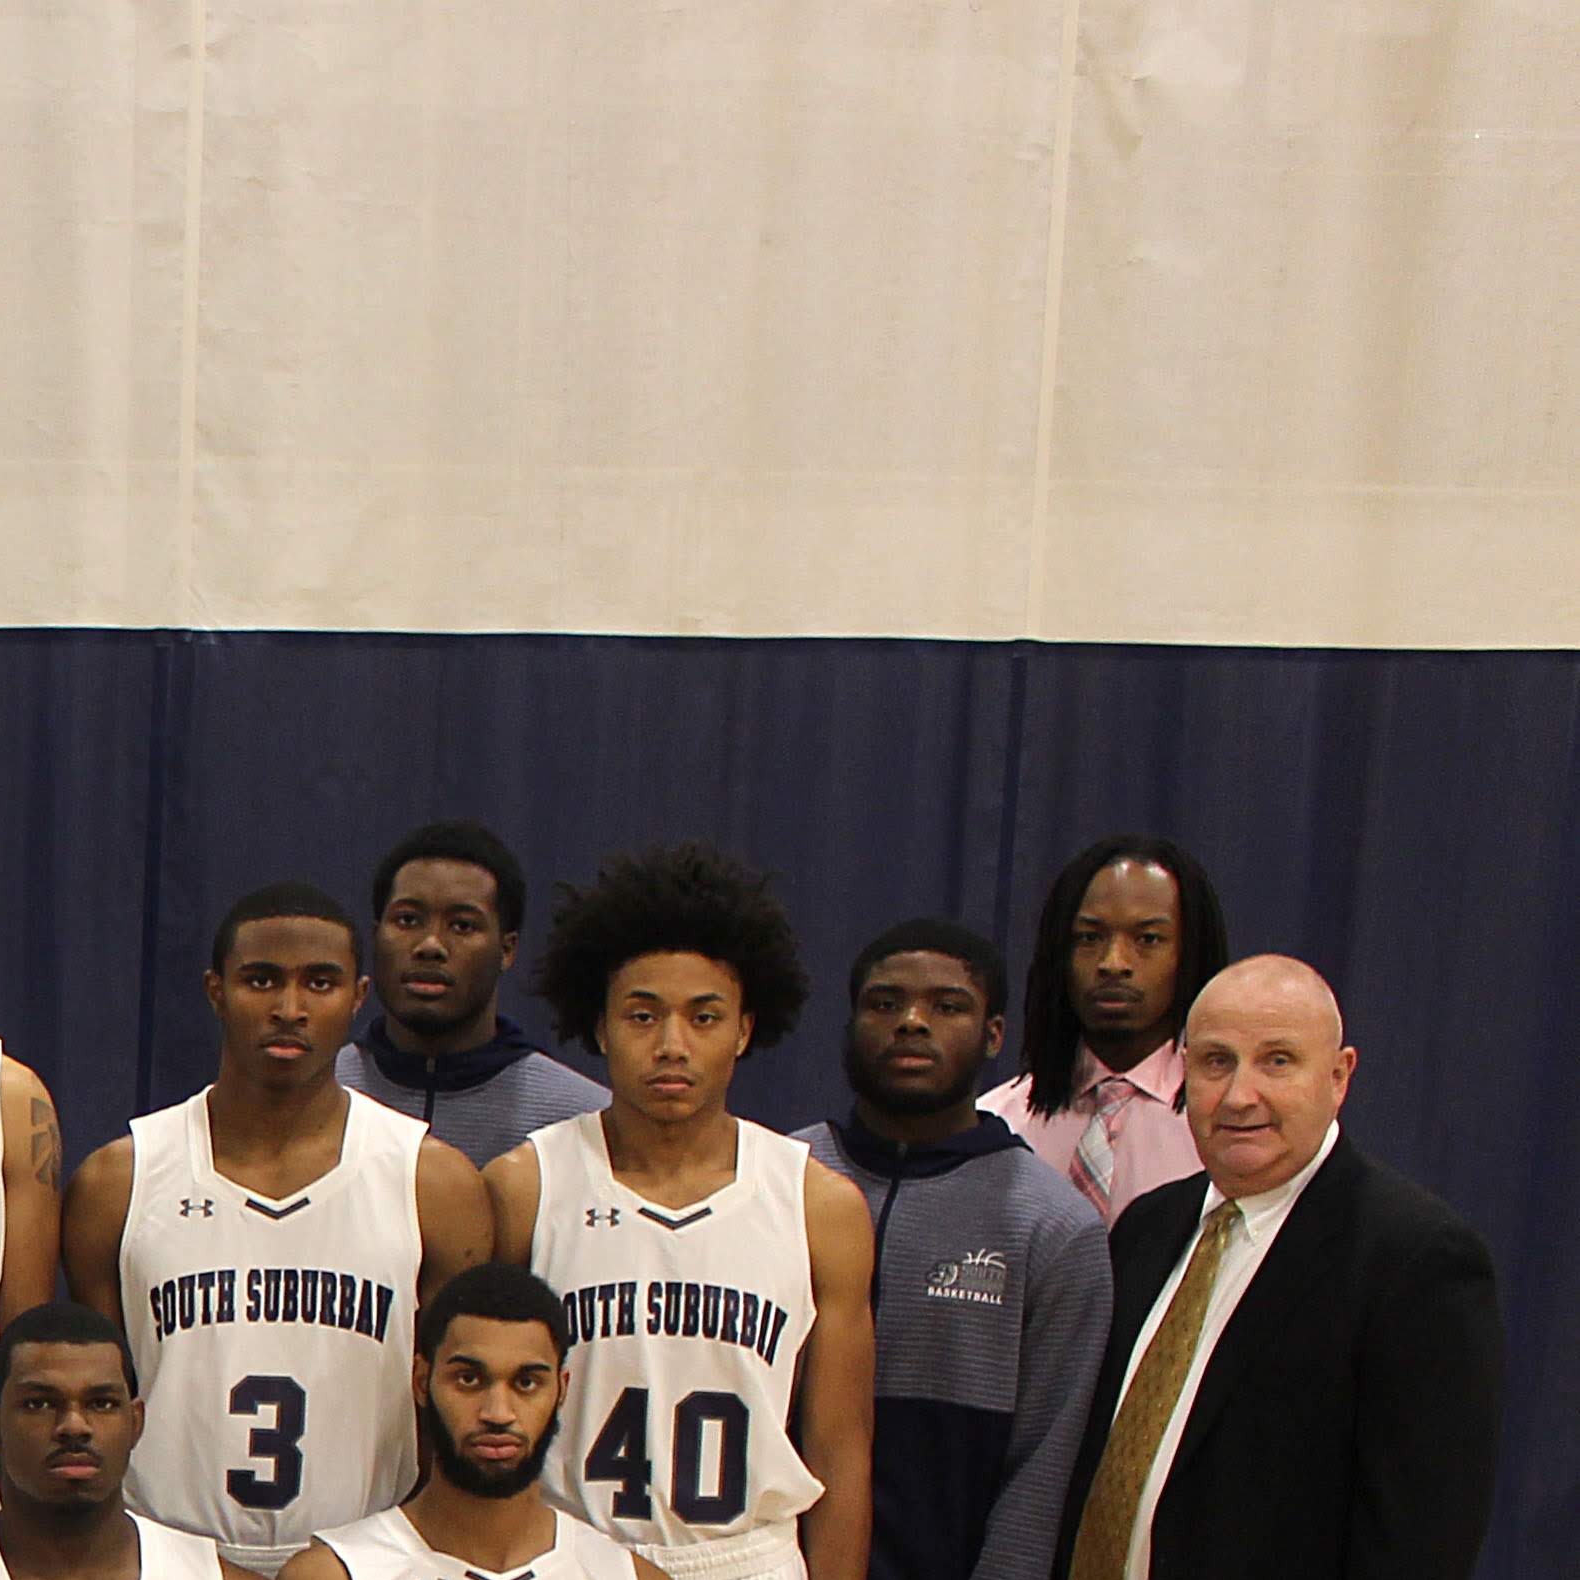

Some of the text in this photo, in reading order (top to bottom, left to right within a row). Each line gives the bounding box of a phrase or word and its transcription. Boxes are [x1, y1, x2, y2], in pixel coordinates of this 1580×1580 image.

[150, 1268, 394, 1344] SOUTH SUBURBAN
[562, 1281, 637, 1347] OUTH
[927, 1286, 1003, 1305] BASKETBALL
[225, 1375, 307, 1511] 3
[584, 1387, 750, 1526] 40
